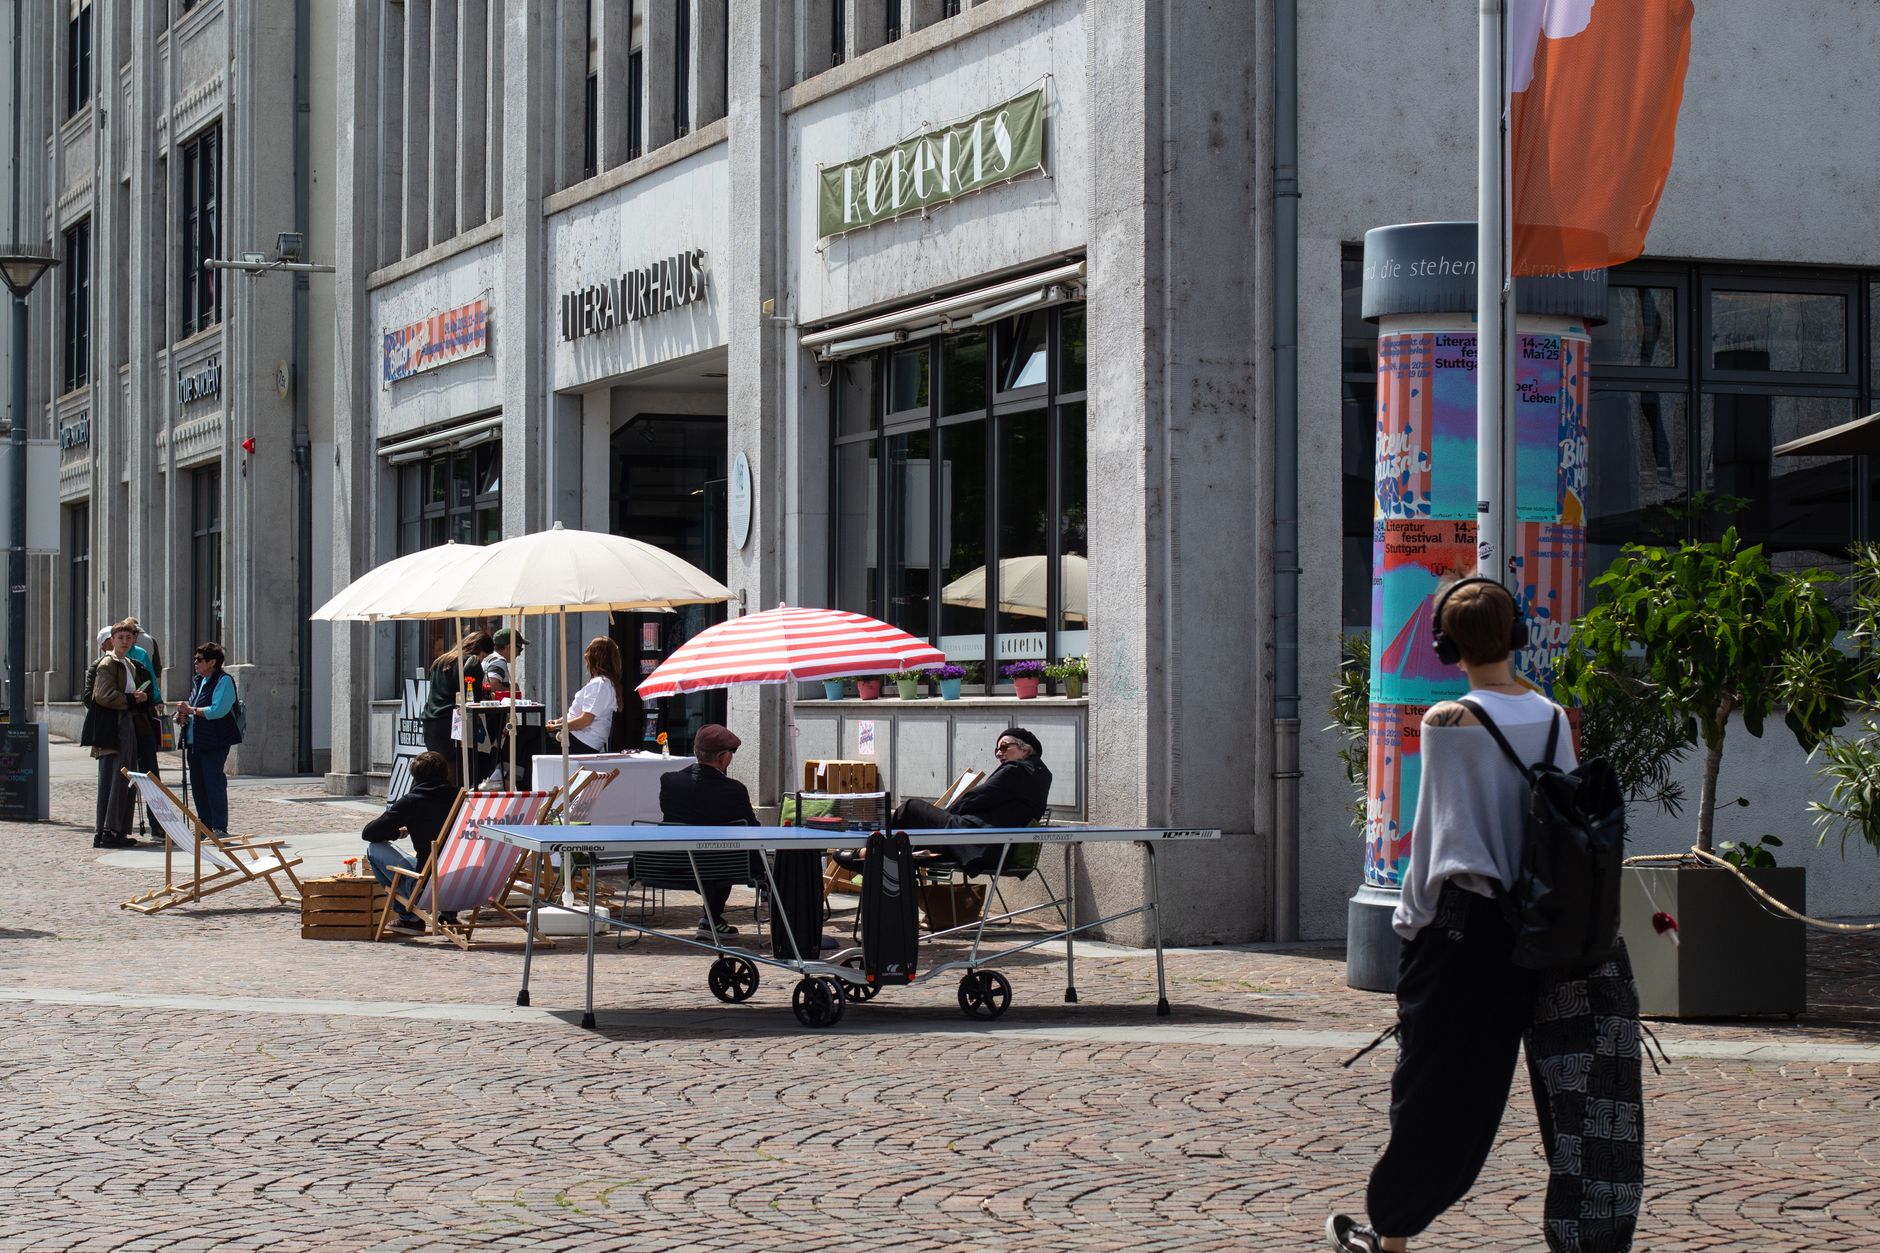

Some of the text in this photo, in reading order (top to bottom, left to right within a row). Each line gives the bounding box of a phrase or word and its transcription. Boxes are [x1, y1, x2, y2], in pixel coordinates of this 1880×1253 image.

[1381, 258, 1401, 279] die
[1410, 255, 1477, 277] stehen
[561, 248, 705, 342] LITERATURHAUS
[1435, 336, 1478, 347] Literat
[1523, 349, 1545, 359] Mai
[1546, 350, 1559, 361] 25
[1435, 358, 1478, 371] Stuttga
[1522, 393, 1556, 404] Leben
[1386, 521, 1425, 532] Literatur
[1402, 532, 1443, 543] festival
[1385, 543, 1427, 555] Stuttgart
